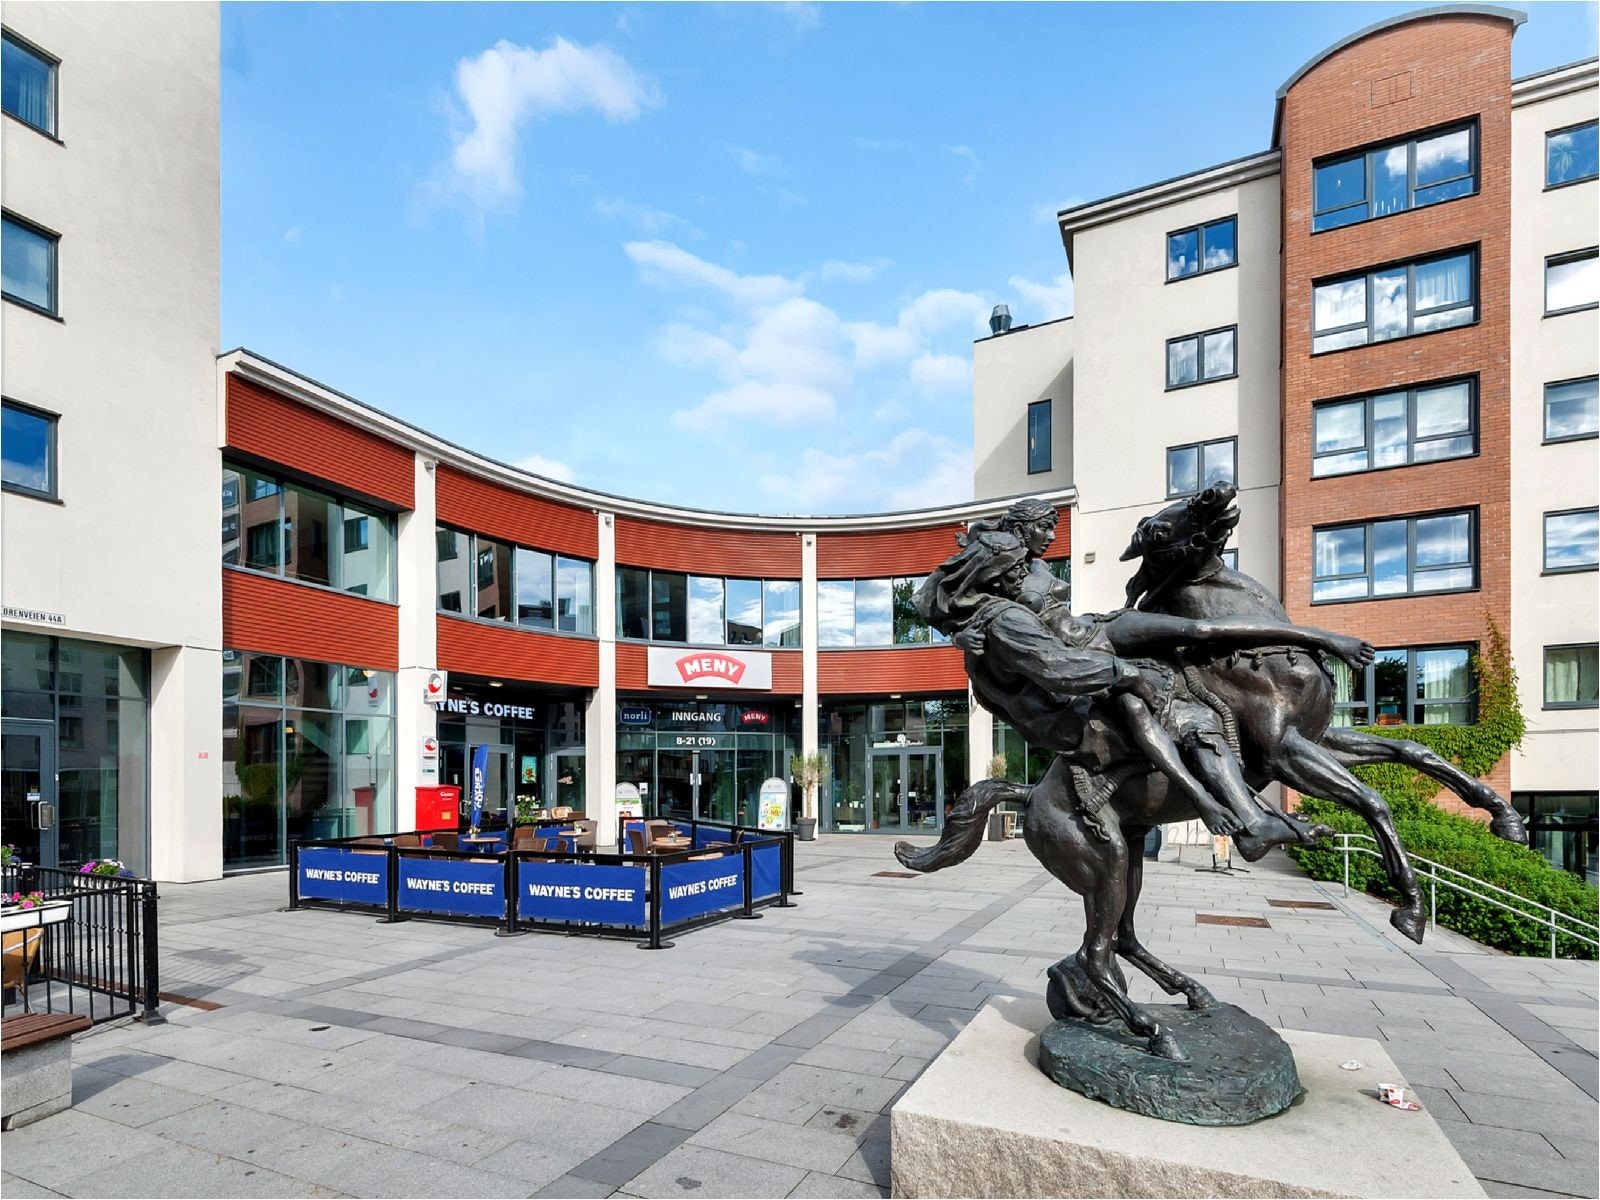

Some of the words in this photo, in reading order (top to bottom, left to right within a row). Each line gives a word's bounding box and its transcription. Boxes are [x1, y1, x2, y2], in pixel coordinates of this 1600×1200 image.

[48, 614, 62, 623] 44A
[683, 658, 740, 676] MENY
[484, 702, 533, 719] COFFEE
[623, 709, 648, 720] norli
[672, 712, 722, 722] INNGANG
[743, 713, 767, 721] MENY
[675, 737, 696, 745] 8-21
[697, 737, 716, 746] (19)
[306, 868, 342, 881] WAYNE'S
[344, 871, 379, 884] COFFEE
[407, 877, 450, 892] WAYNE'S
[453, 880, 494, 895] COFFEE
[529, 883, 581, 899] WAYNE'S
[584, 886, 634, 902] COFFEE
[668, 882, 706, 899] WAYNE'S
[708, 874, 738, 891] COFFEE
